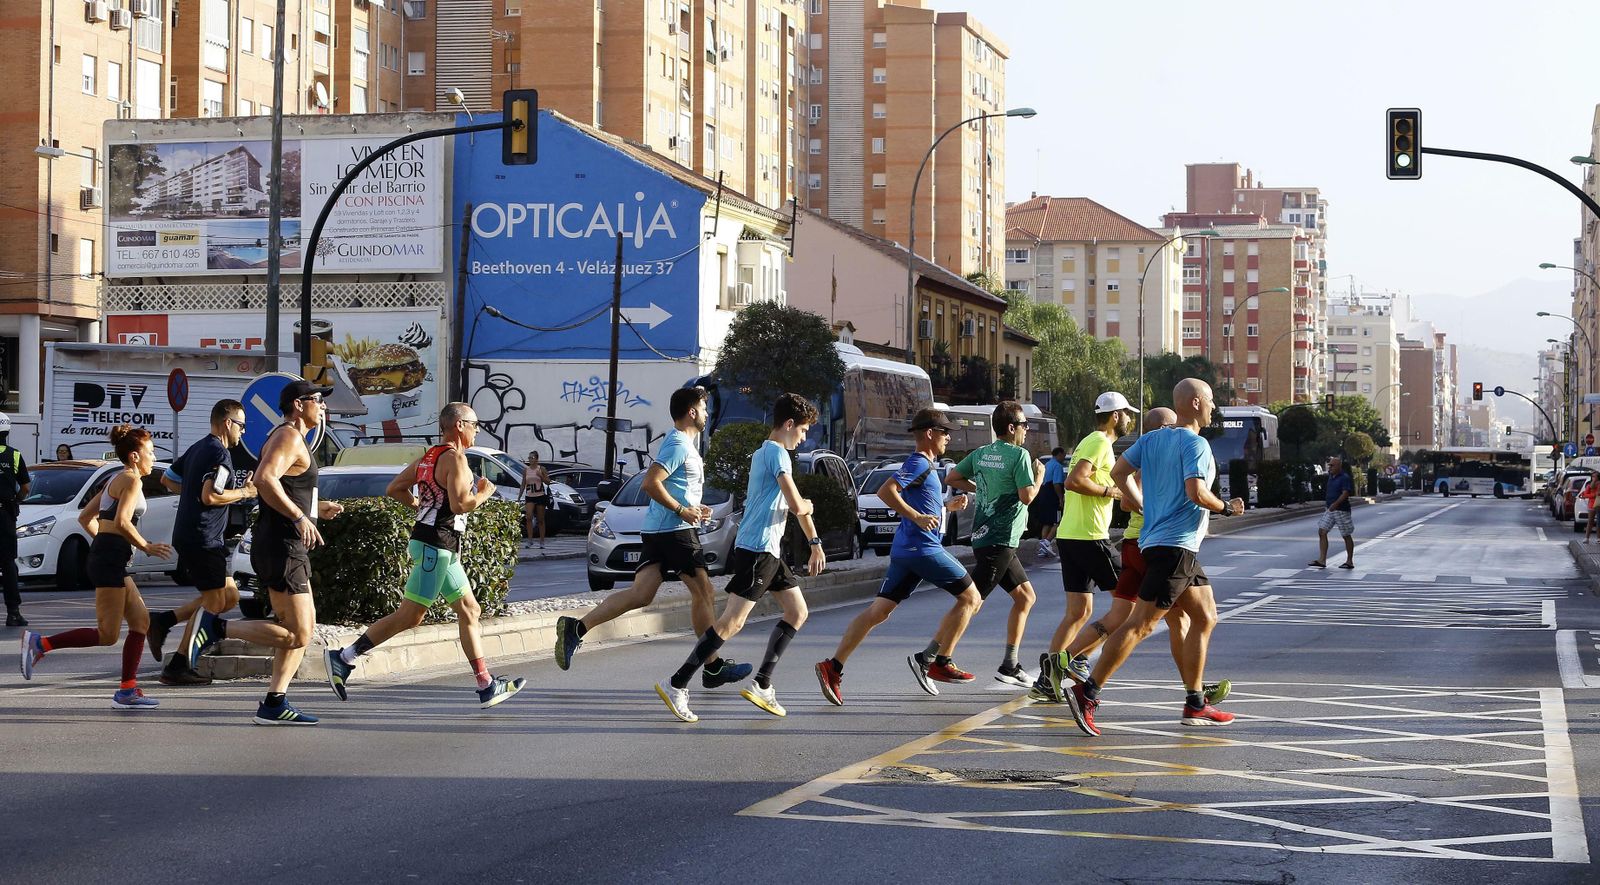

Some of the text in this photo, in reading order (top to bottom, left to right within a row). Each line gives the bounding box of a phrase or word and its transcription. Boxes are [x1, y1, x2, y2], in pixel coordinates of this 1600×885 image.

[402, 144, 424, 160] EN
[366, 162, 425, 182] MEJOR
[309, 180, 426, 195] Sin Slir del Barrio
[345, 196, 373, 208] CON
[378, 195, 425, 206] PISCINA
[163, 235, 195, 243] guamar
[142, 250, 159, 259] 667
[162, 249, 180, 259] 610
[182, 248, 200, 258] 495
[471, 260, 551, 275] Beethoven
[555, 261, 565, 275] 4
[577, 260, 652, 277] Velázquez
[656, 261, 674, 275] 37
[401, 399, 419, 409] KFC
[90, 411, 155, 425] TELECOM
[61, 424, 76, 435] de
[525, 482, 545, 494] FILA
